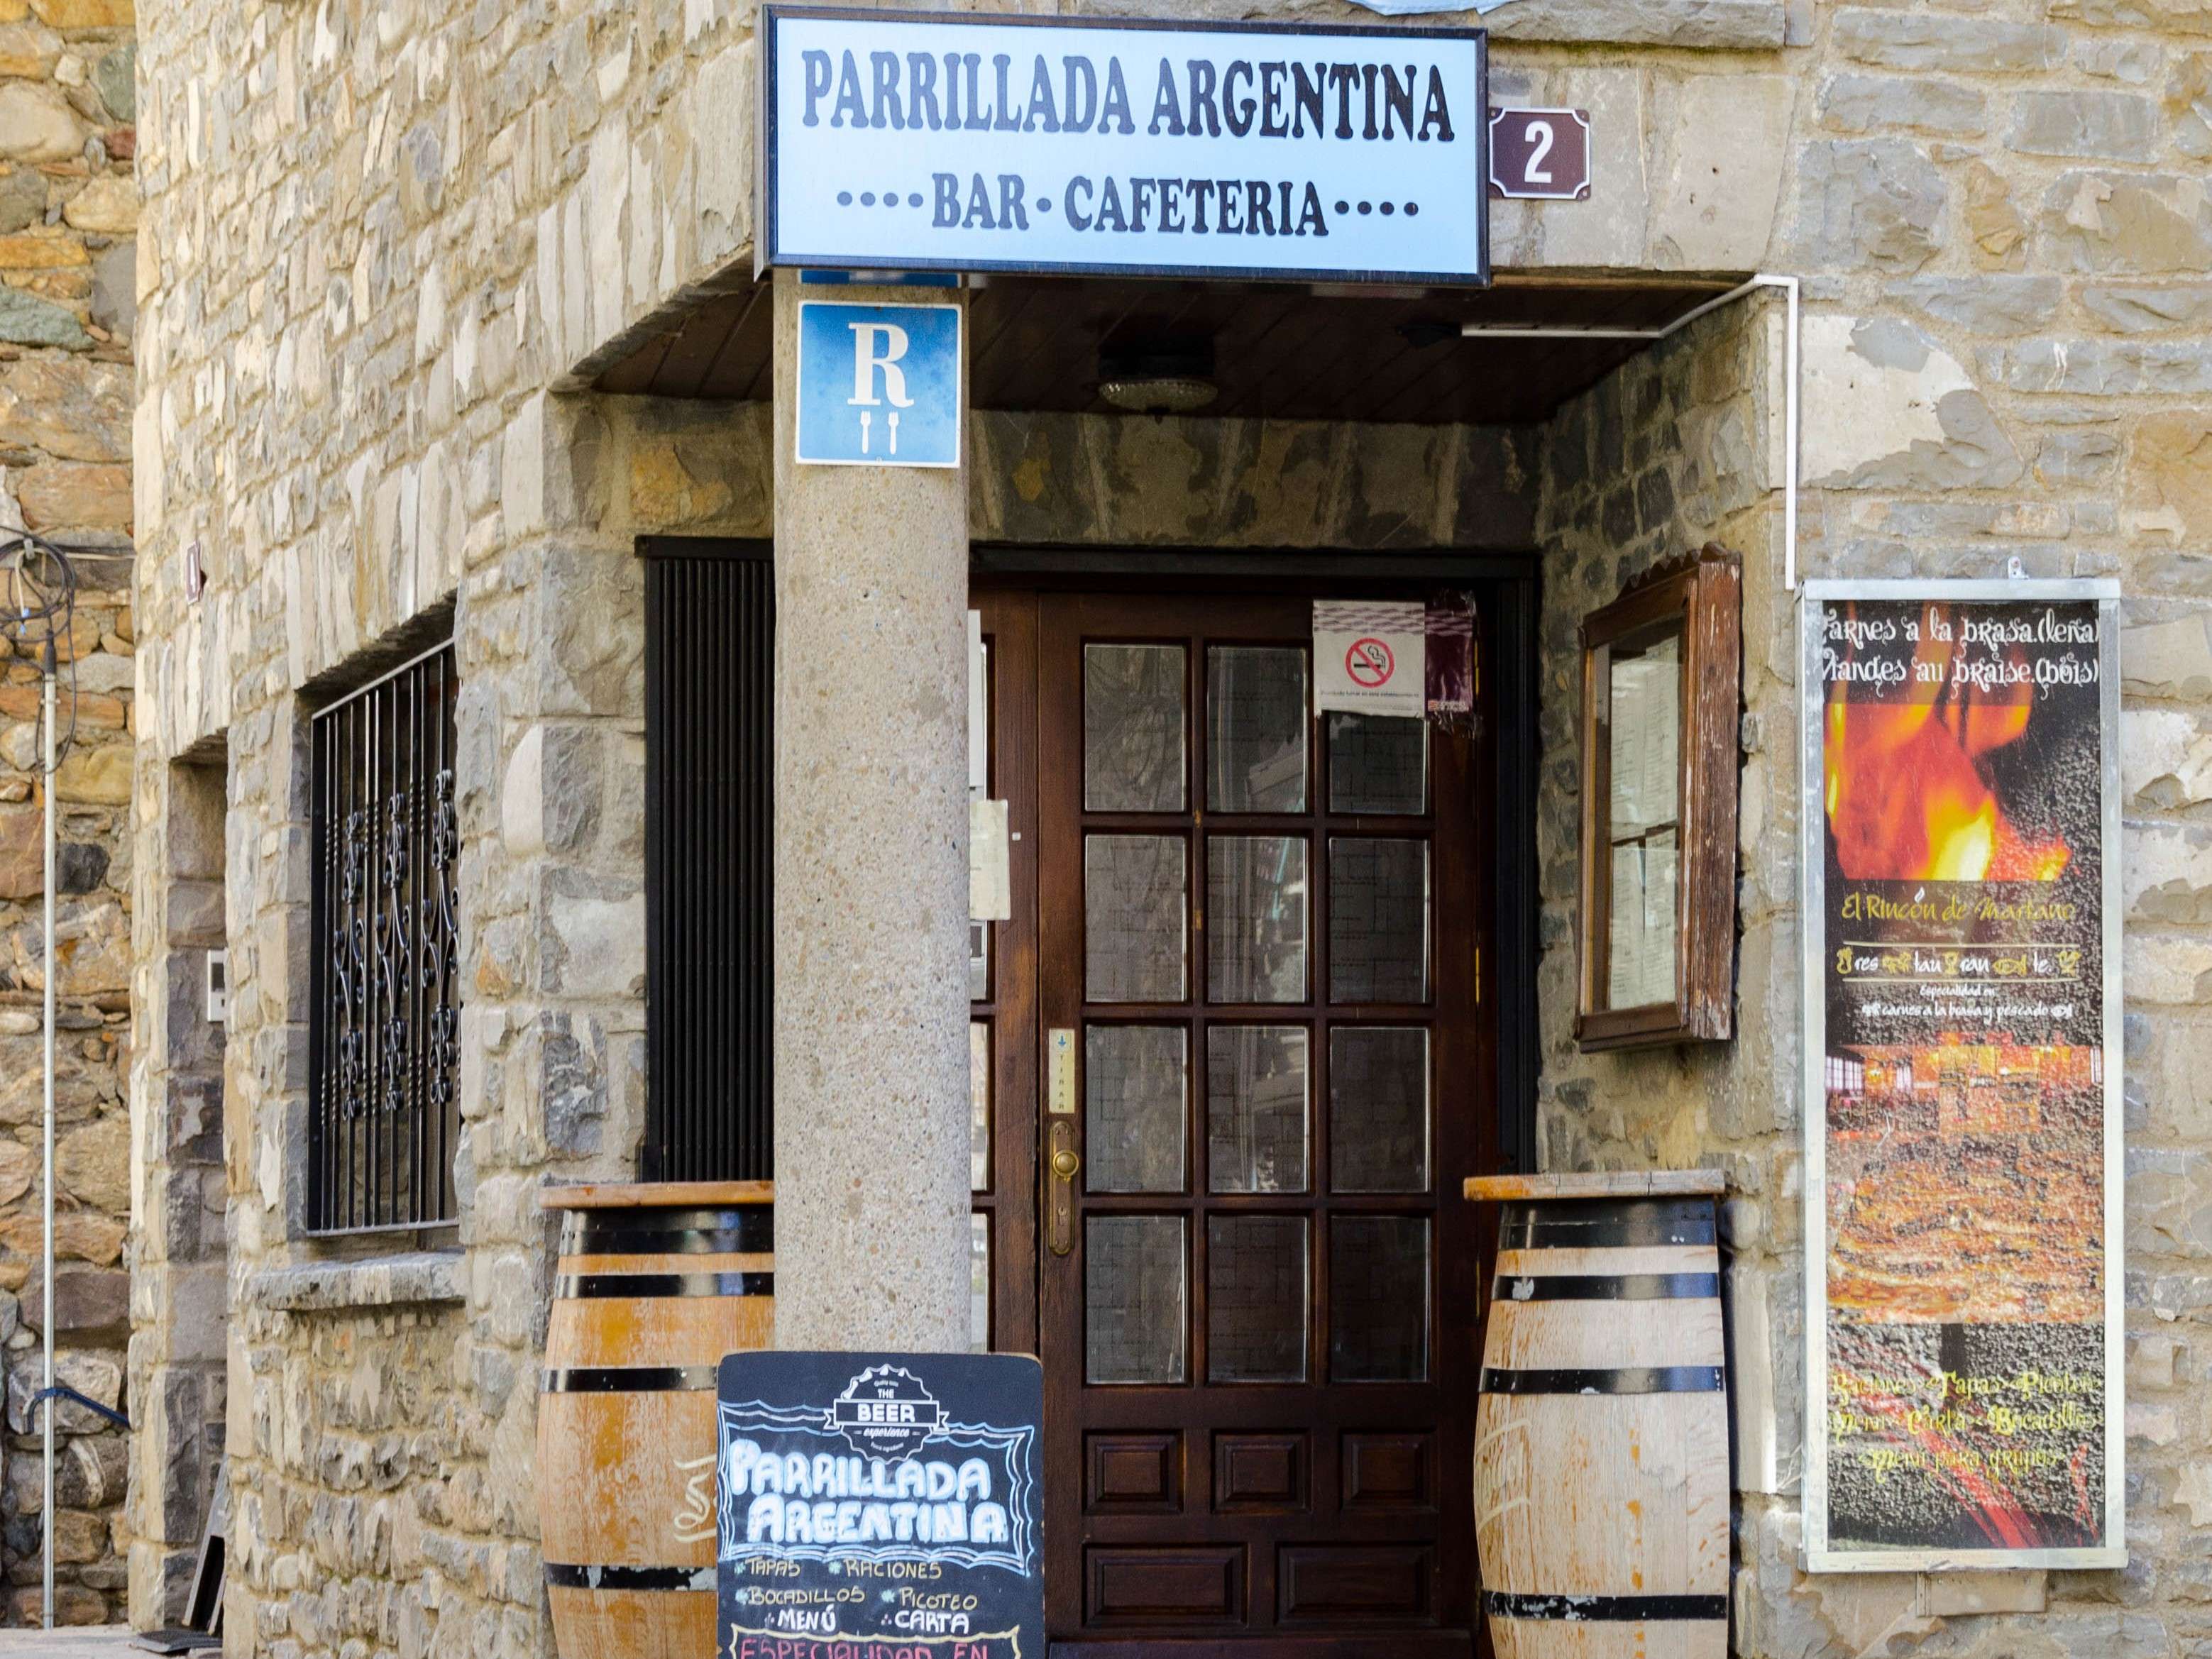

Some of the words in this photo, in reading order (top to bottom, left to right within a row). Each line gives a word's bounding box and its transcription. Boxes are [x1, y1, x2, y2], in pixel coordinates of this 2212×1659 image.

[802, 49, 1136, 135] PARRILLADA
[1148, 57, 1456, 143] ARGENTINA
[1524, 121, 1555, 184] 2
[931, 173, 1029, 231] BAR
[1064, 175, 1328, 237] CAFETERIA
[847, 323, 915, 409] R
[1901, 616, 1920, 641] a
[1930, 607, 1953, 641] la
[1911, 656, 1944, 682] au
[1842, 891, 1861, 921] El
[1942, 894, 1967, 922] de
[1854, 956, 1879, 971] res
[1914, 950, 1942, 973] tau
[1959, 956, 1990, 973] ran
[1920, 983, 1981, 1001] Especialidad
[1882, 1005, 1920, 1015] carnes
[1935, 1001, 1947, 1016] la
[1949, 1001, 1981, 1017] brasa
[1996, 1001, 2049, 1023] pescado
[878, 1389, 894, 1399] THE
[857, 1404, 915, 1422] BEER
[863, 1427, 910, 1438] experience
[729, 1438, 992, 1501] PARRILLADA
[747, 1492, 1008, 1543] ARGENTINA
[745, 1559, 800, 1577] TAPAS
[842, 1560, 942, 1579] RACIONES
[749, 1585, 866, 1605] BOCADILLOS
[899, 1587, 977, 1610] PICOTEO
[778, 1604, 836, 1631] MENÚ
[894, 1610, 969, 1634] CARTA
